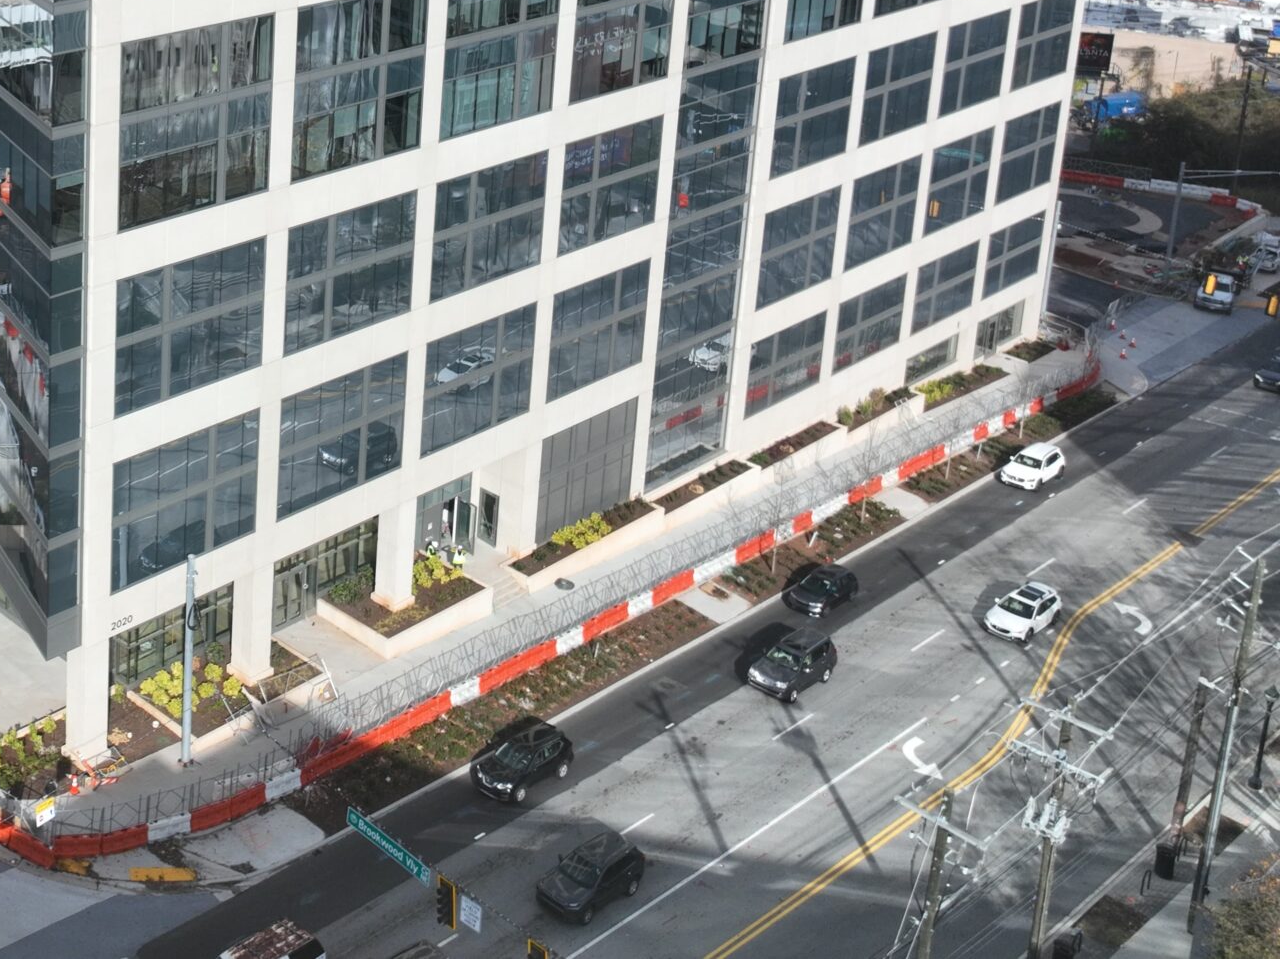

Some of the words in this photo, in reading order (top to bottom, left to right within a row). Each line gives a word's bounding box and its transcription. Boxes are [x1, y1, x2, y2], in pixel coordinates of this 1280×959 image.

[1080, 48, 1109, 57] LANTA
[111, 614, 133, 631] 2020
[358, 819, 404, 861] Brookwood
[405, 855, 419, 874] Vly
